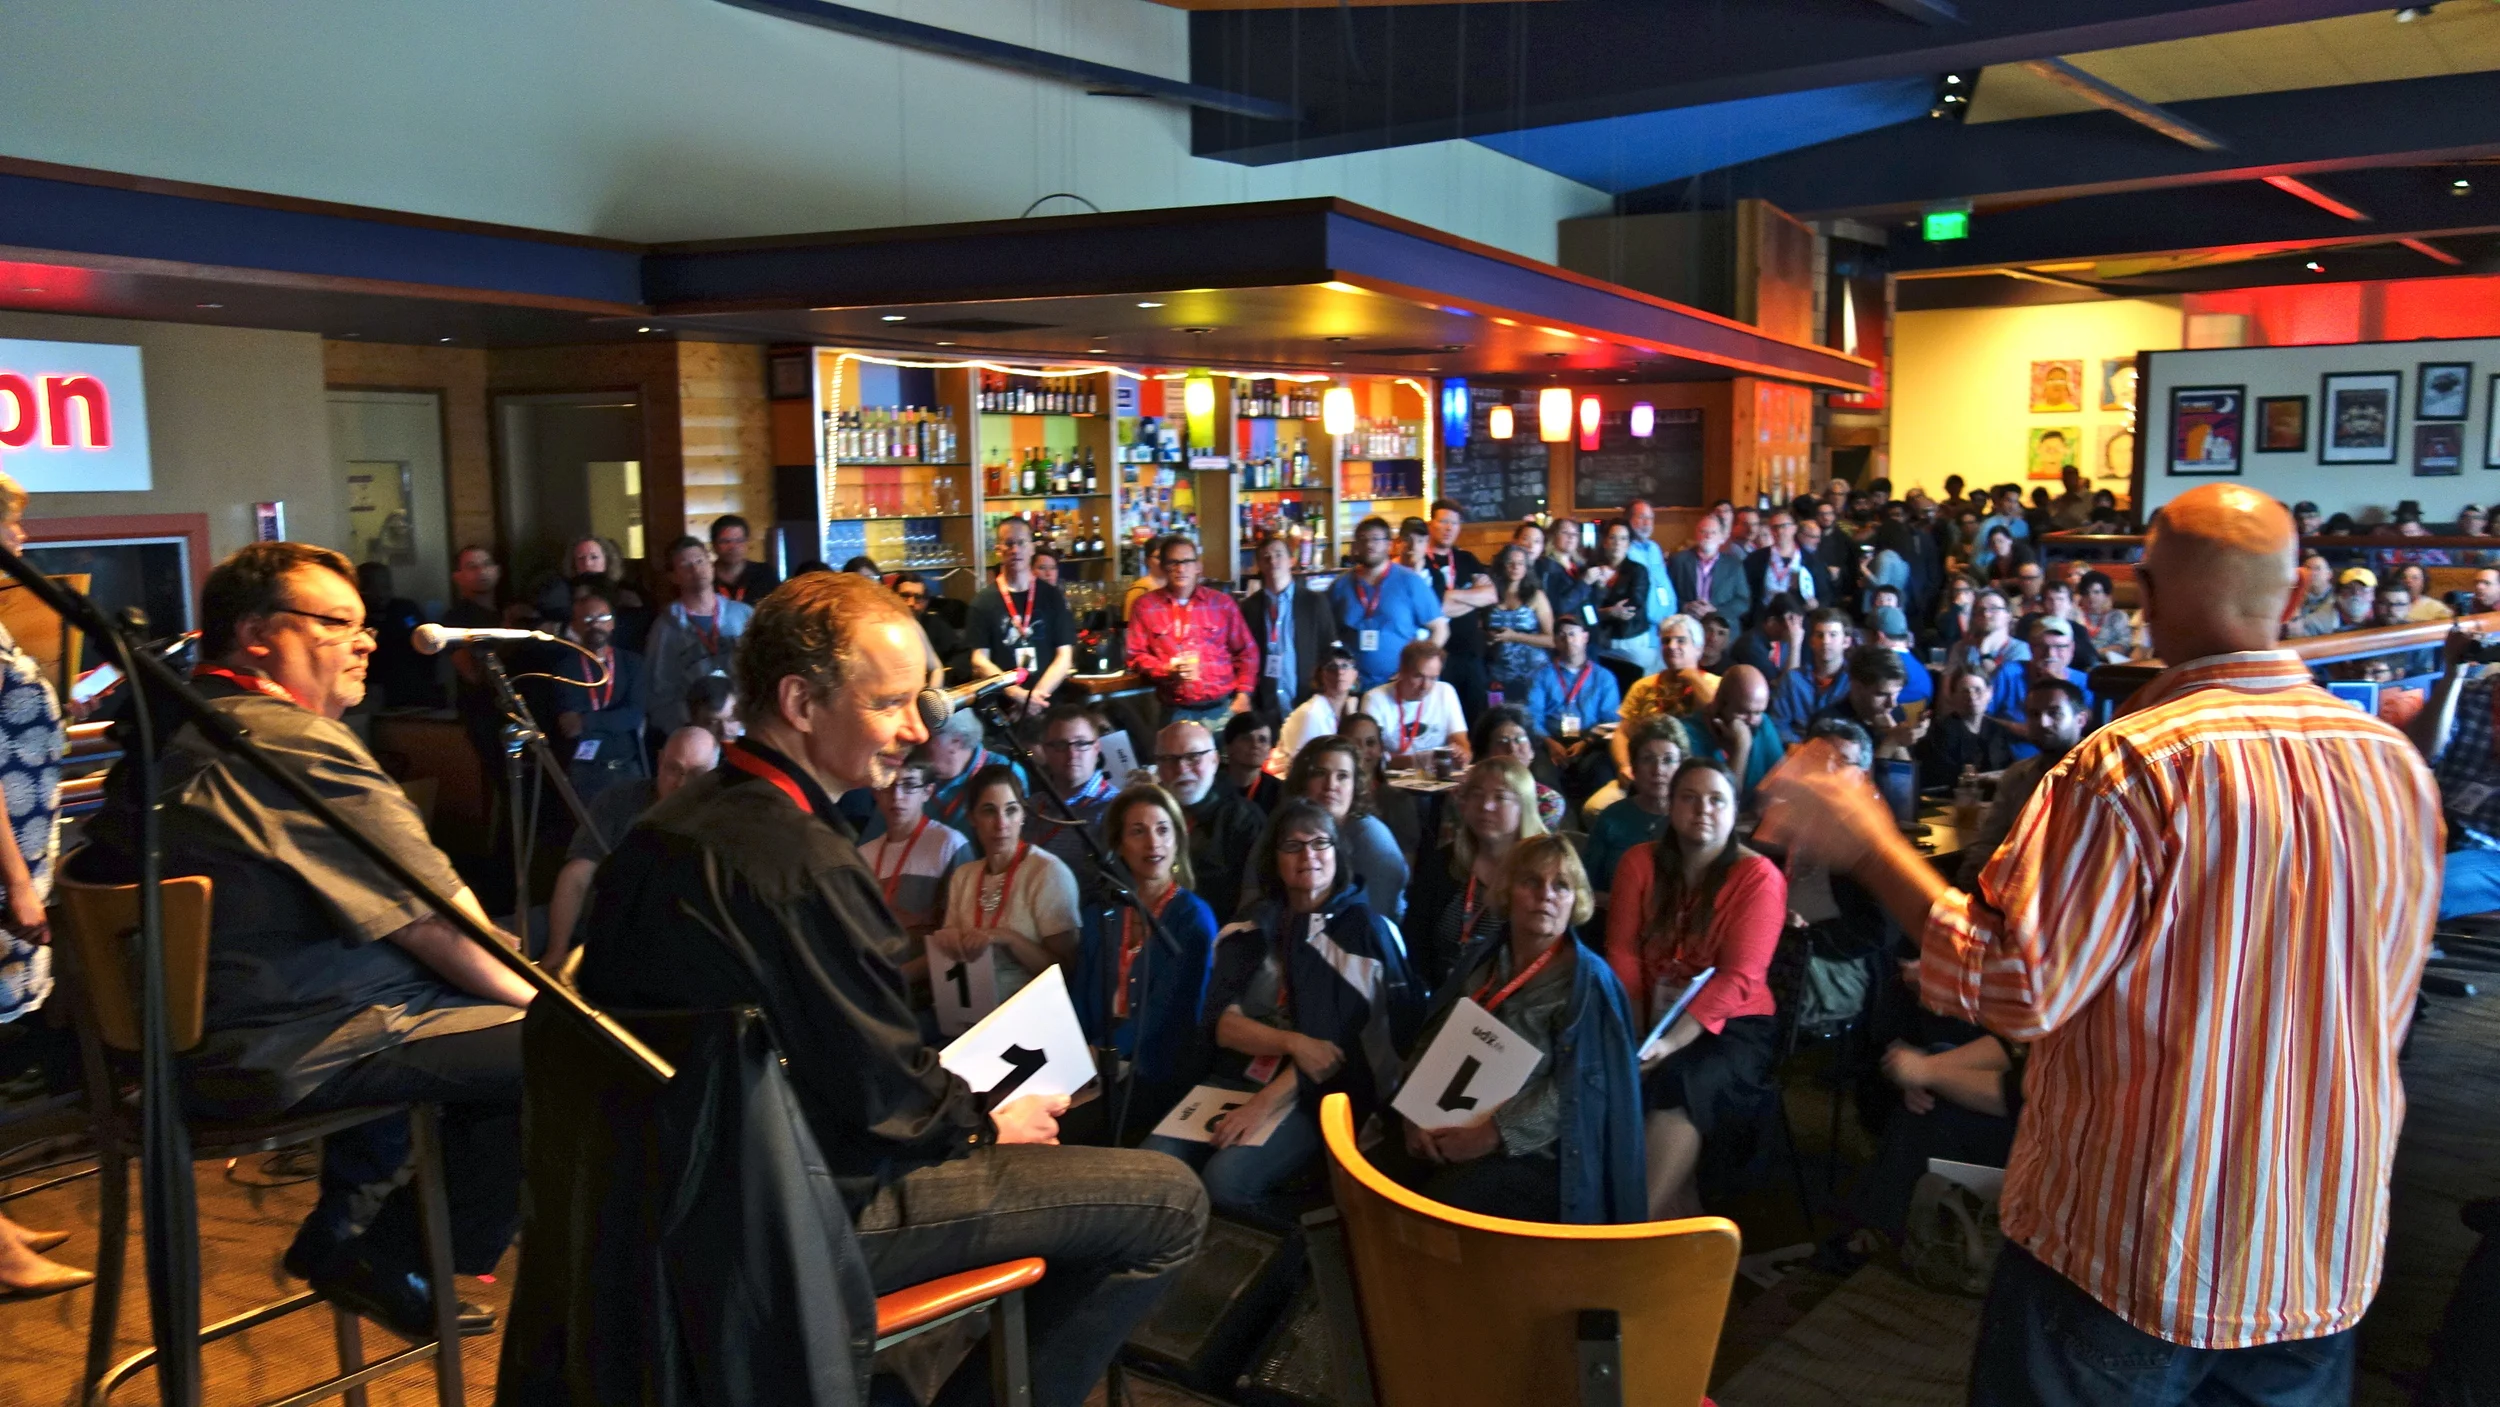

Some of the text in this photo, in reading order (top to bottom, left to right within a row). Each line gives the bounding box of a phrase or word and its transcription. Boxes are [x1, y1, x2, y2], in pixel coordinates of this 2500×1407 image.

[945, 962, 971, 1008] 1
[986, 1043, 1049, 1113] 1
[1436, 1054, 1482, 1112] 1
